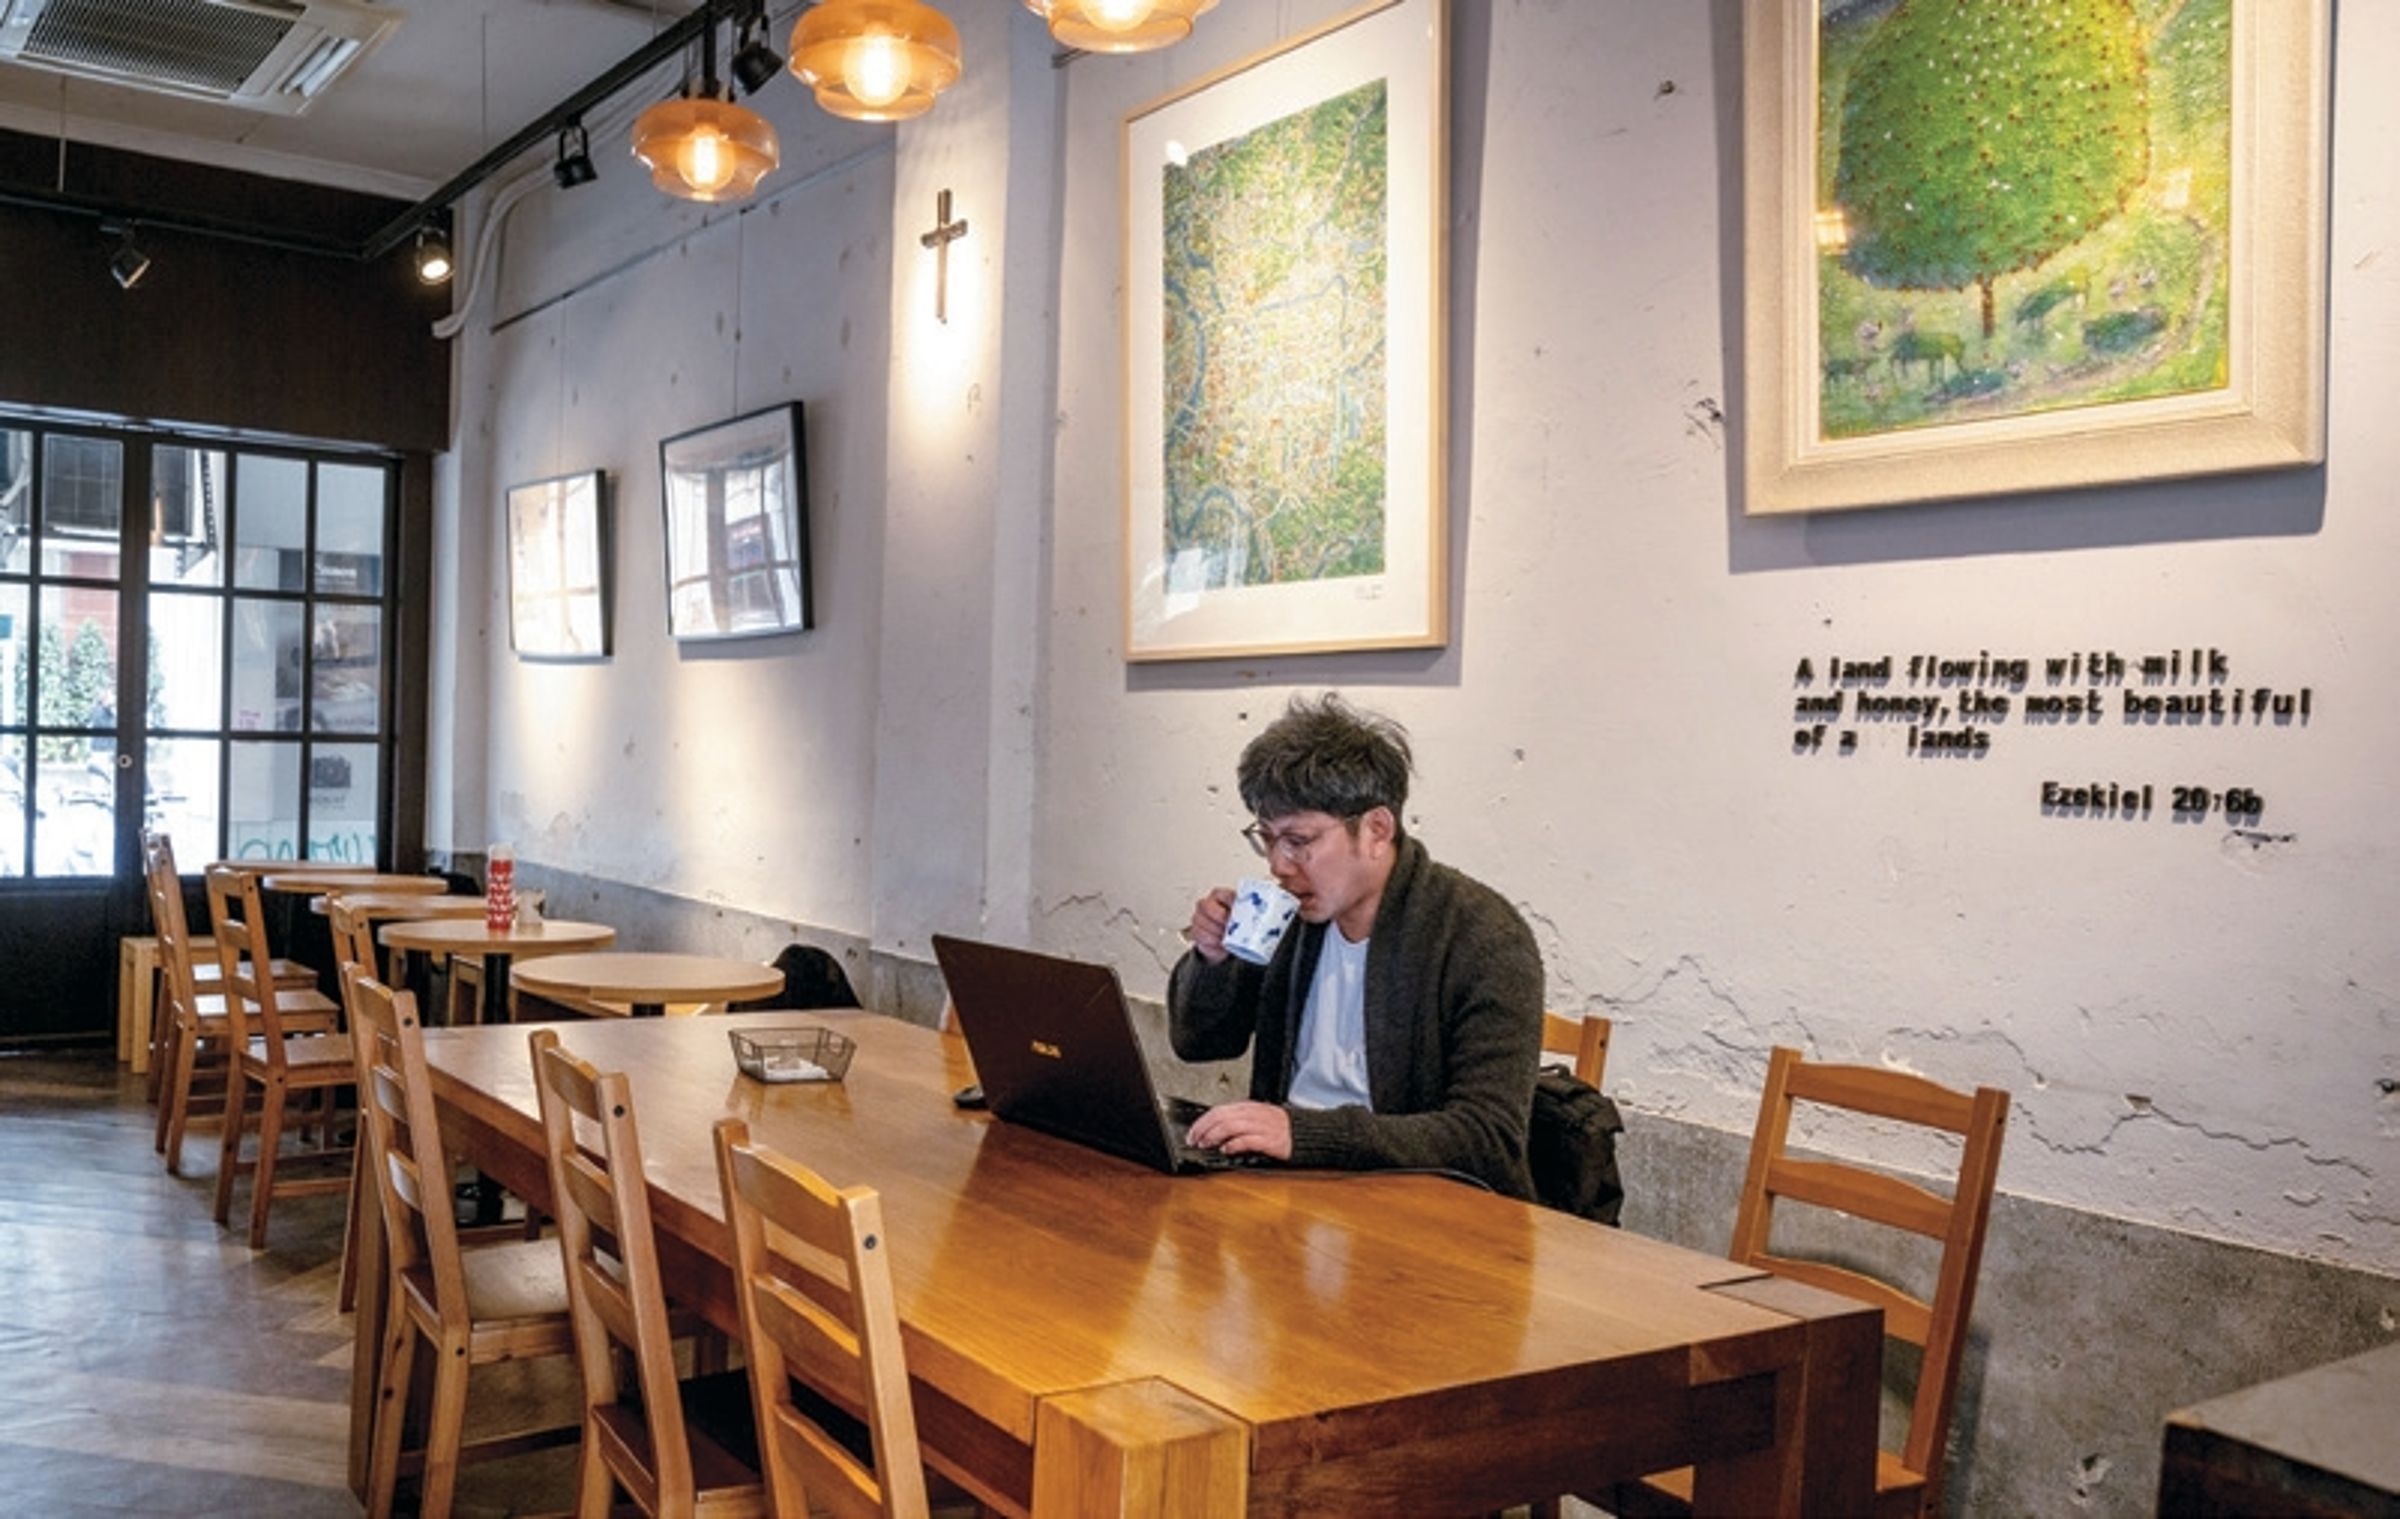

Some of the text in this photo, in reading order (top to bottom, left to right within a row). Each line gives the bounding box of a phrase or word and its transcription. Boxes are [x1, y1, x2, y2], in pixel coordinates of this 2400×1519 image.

[1796, 648, 2229, 684] A land flowing with milk
[1794, 688, 2311, 721] and honey, the most beautiful
[1794, 724, 1990, 749] of a lands
[2041, 782, 2153, 811] Ezekiel
